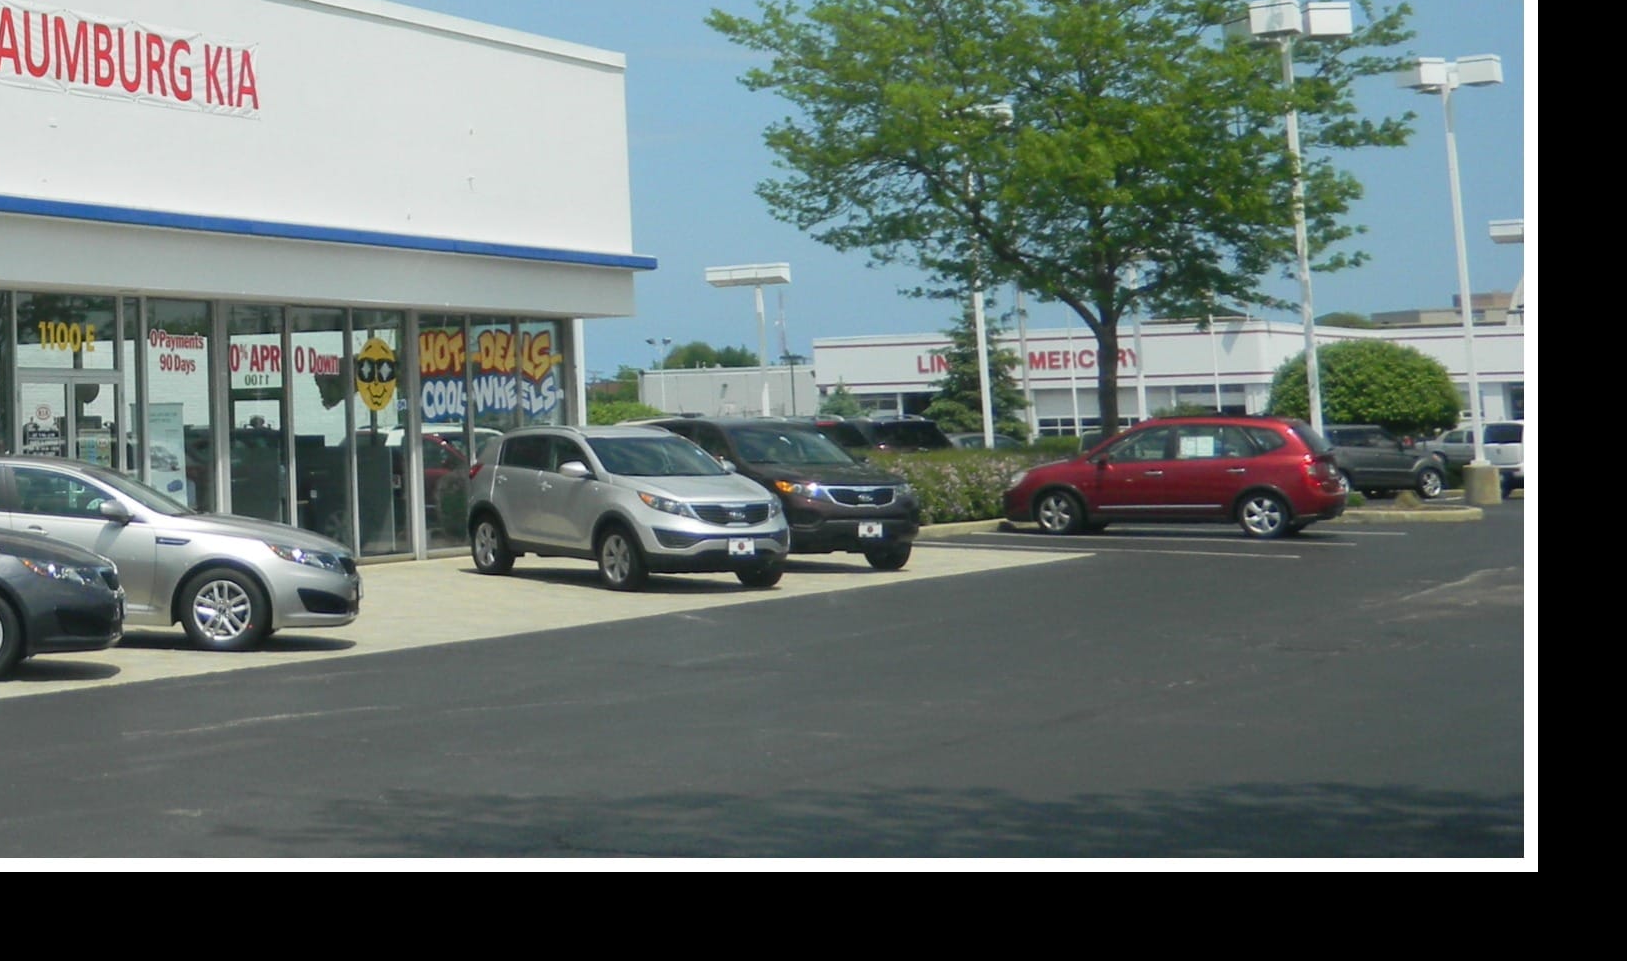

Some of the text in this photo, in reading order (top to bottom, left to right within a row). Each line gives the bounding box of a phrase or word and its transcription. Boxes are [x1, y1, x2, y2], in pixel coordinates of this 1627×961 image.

[204, 45, 259, 110] KIA
[38, 321, 96, 352] 1100 E
[159, 331, 204, 352] Payments
[159, 354, 196, 375] 90 Days
[250, 344, 281, 372] APR
[309, 347, 340, 375] Down
